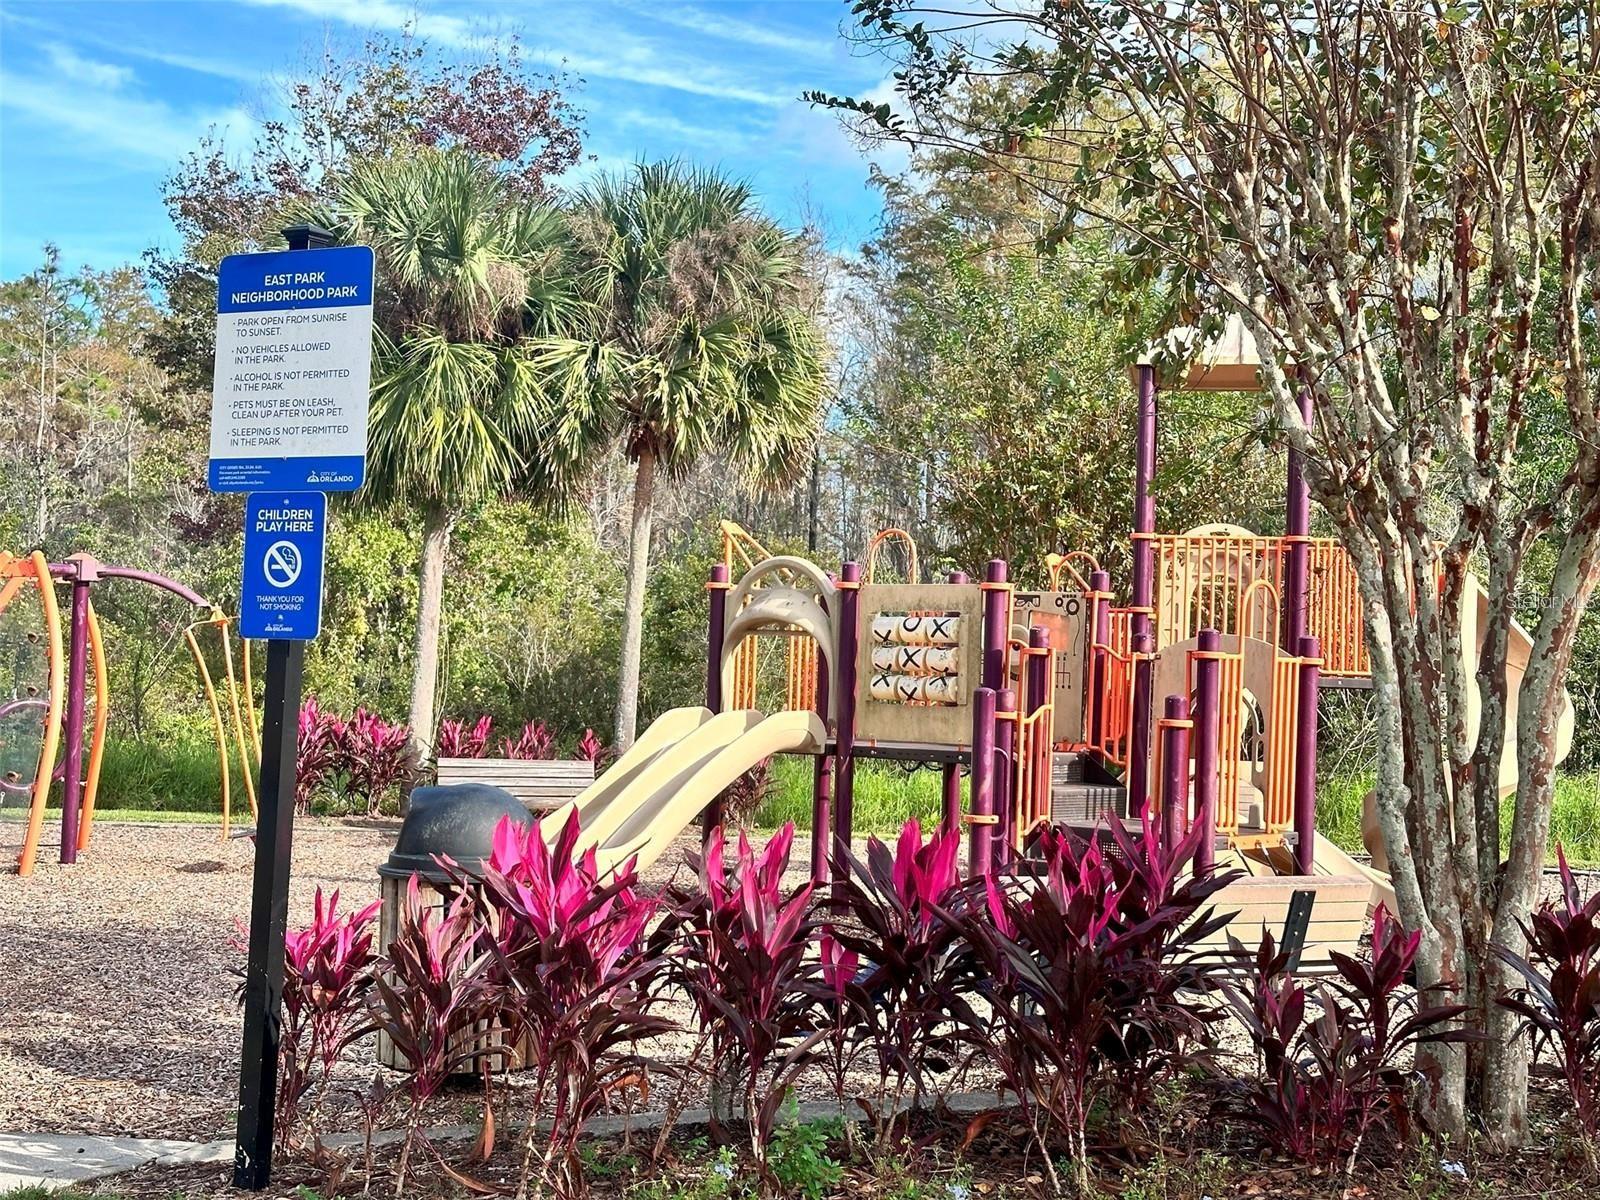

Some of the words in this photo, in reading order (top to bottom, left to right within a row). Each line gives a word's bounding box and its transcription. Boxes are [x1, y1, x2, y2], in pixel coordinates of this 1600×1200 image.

[265, 274, 292, 286] EAST
[295, 272, 325, 284] PARK
[232, 288, 324, 304] NEIGHBORHOOD
[327, 286, 357, 298] PARK
[238, 318, 259, 326] PARK
[261, 317, 283, 325] OPEN
[286, 316, 309, 324] FROM
[312, 313, 347, 322] SUNRISE
[237, 329, 247, 337] TO
[249, 328, 281, 336] SUNSET.
[237, 346, 248, 354] NO
[250, 344, 289, 353] VEHICLES
[291, 343, 330, 352] ALLOWED
[235, 356, 243, 364] IN
[246, 355, 260, 364] THE
[234, 372, 271, 382] ALCOHOL
[275, 371, 281, 380] IS
[284, 371, 300, 379] NOT
[303, 370, 349, 378] PERMITTED
[233, 383, 241, 391] IN
[233, 400, 253, 409] PETS
[292, 399, 304, 407] ON
[307, 398, 335, 407] LEASH,
[232, 410, 258, 419] CLEAN
[273, 409, 299, 417] AFTER
[302, 409, 325, 417] YOUR
[232, 428, 271, 436] SLEEPING
[282, 427, 299, 435] NOT
[302, 426, 348, 434] PERMITTED
[258, 510, 312, 520] CHILDREN
[256, 522, 283, 532] PLAY
[285, 522, 314, 532] HERE
